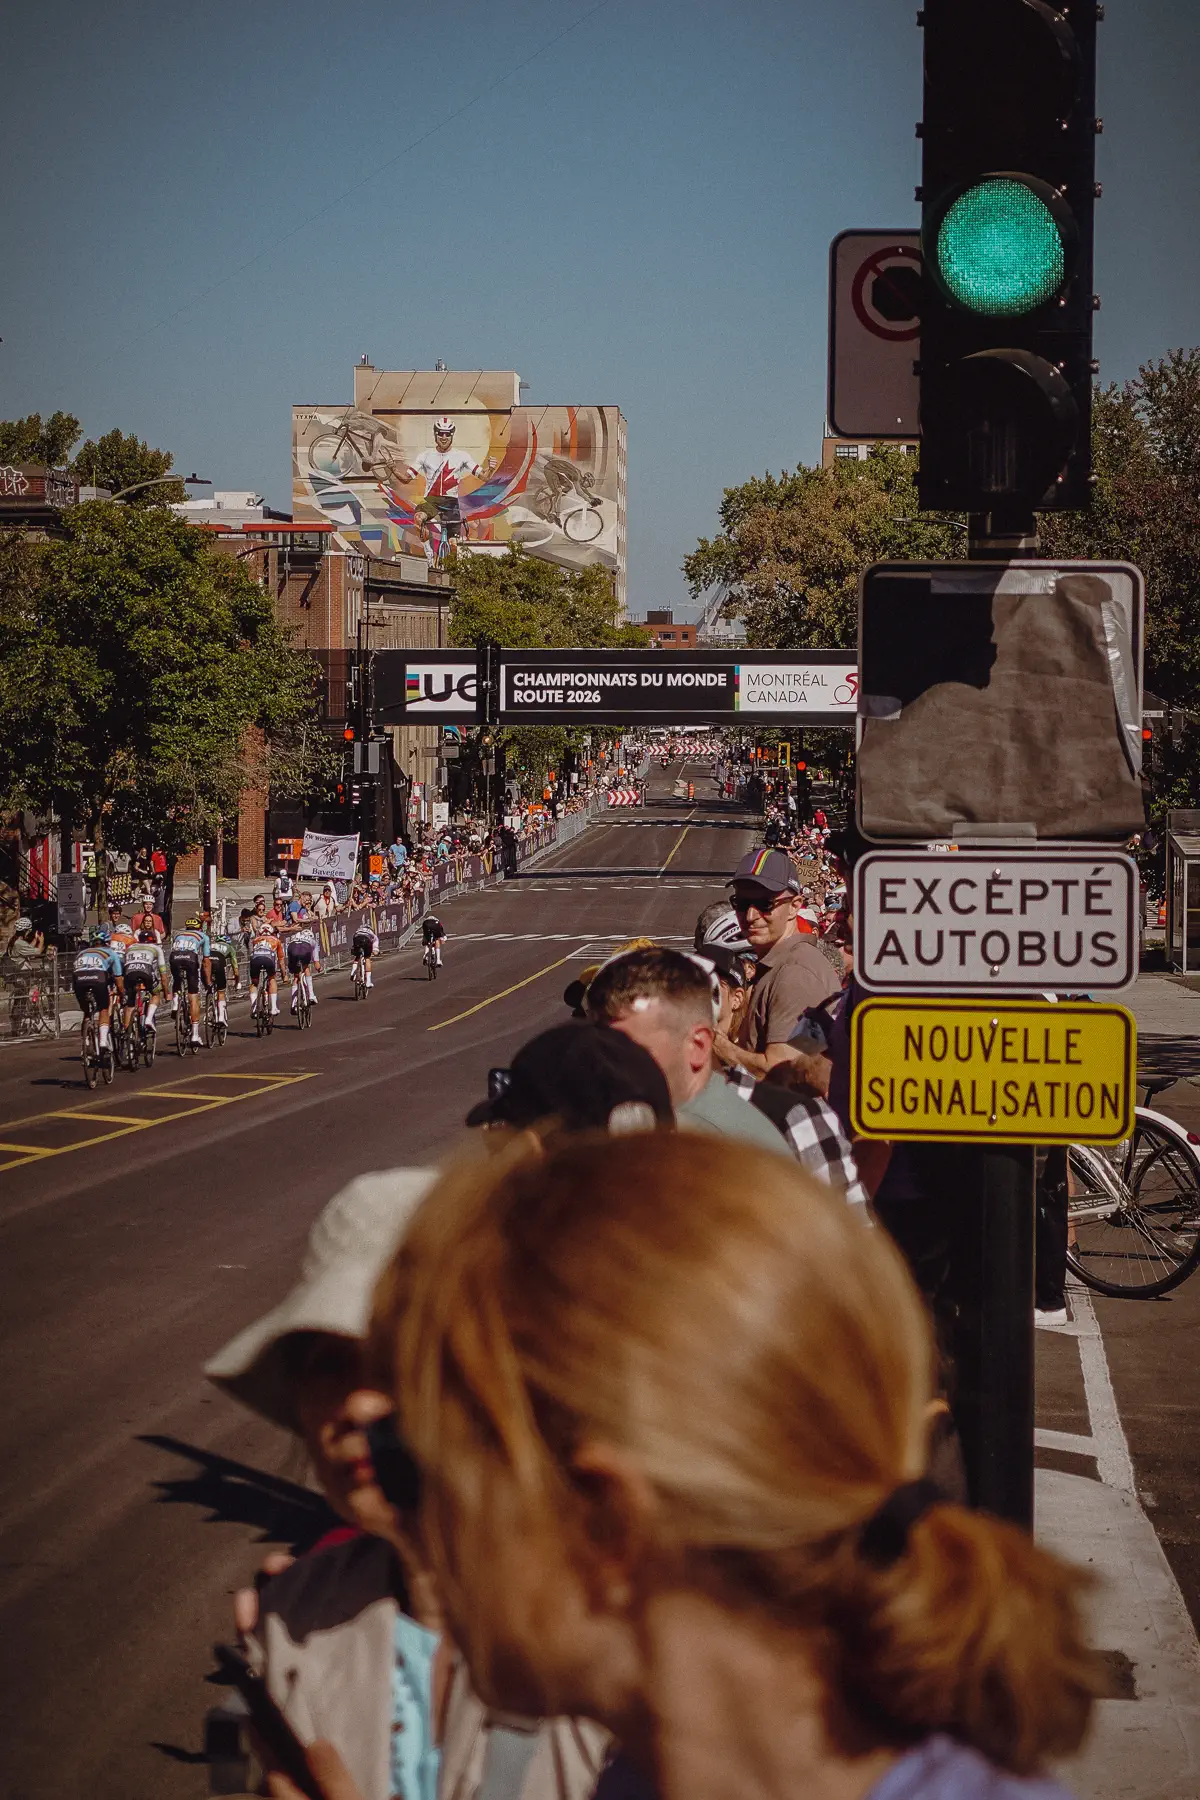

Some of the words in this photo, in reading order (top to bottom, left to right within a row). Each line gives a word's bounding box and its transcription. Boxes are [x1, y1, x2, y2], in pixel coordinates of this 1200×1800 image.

[513, 673, 638, 687] CHAMPIONNATS
[641, 673, 663, 687] DU
[667, 673, 727, 687] MONDE
[747, 670, 828, 687] MONTRÉAL
[424, 673, 477, 702] UC
[513, 690, 564, 703] ROUTE
[567, 690, 601, 703] 2026
[746, 690, 808, 703] CANADA
[312, 867, 346, 878] Bavegem
[878, 867, 1112, 916] EXCEPTÉ
[721, 926, 740, 940] SCOT
[873, 929, 1118, 967] AUTOBUS
[903, 1025, 1083, 1065] NOUVELLE
[866, 1077, 1120, 1120] SIGNALISATION
